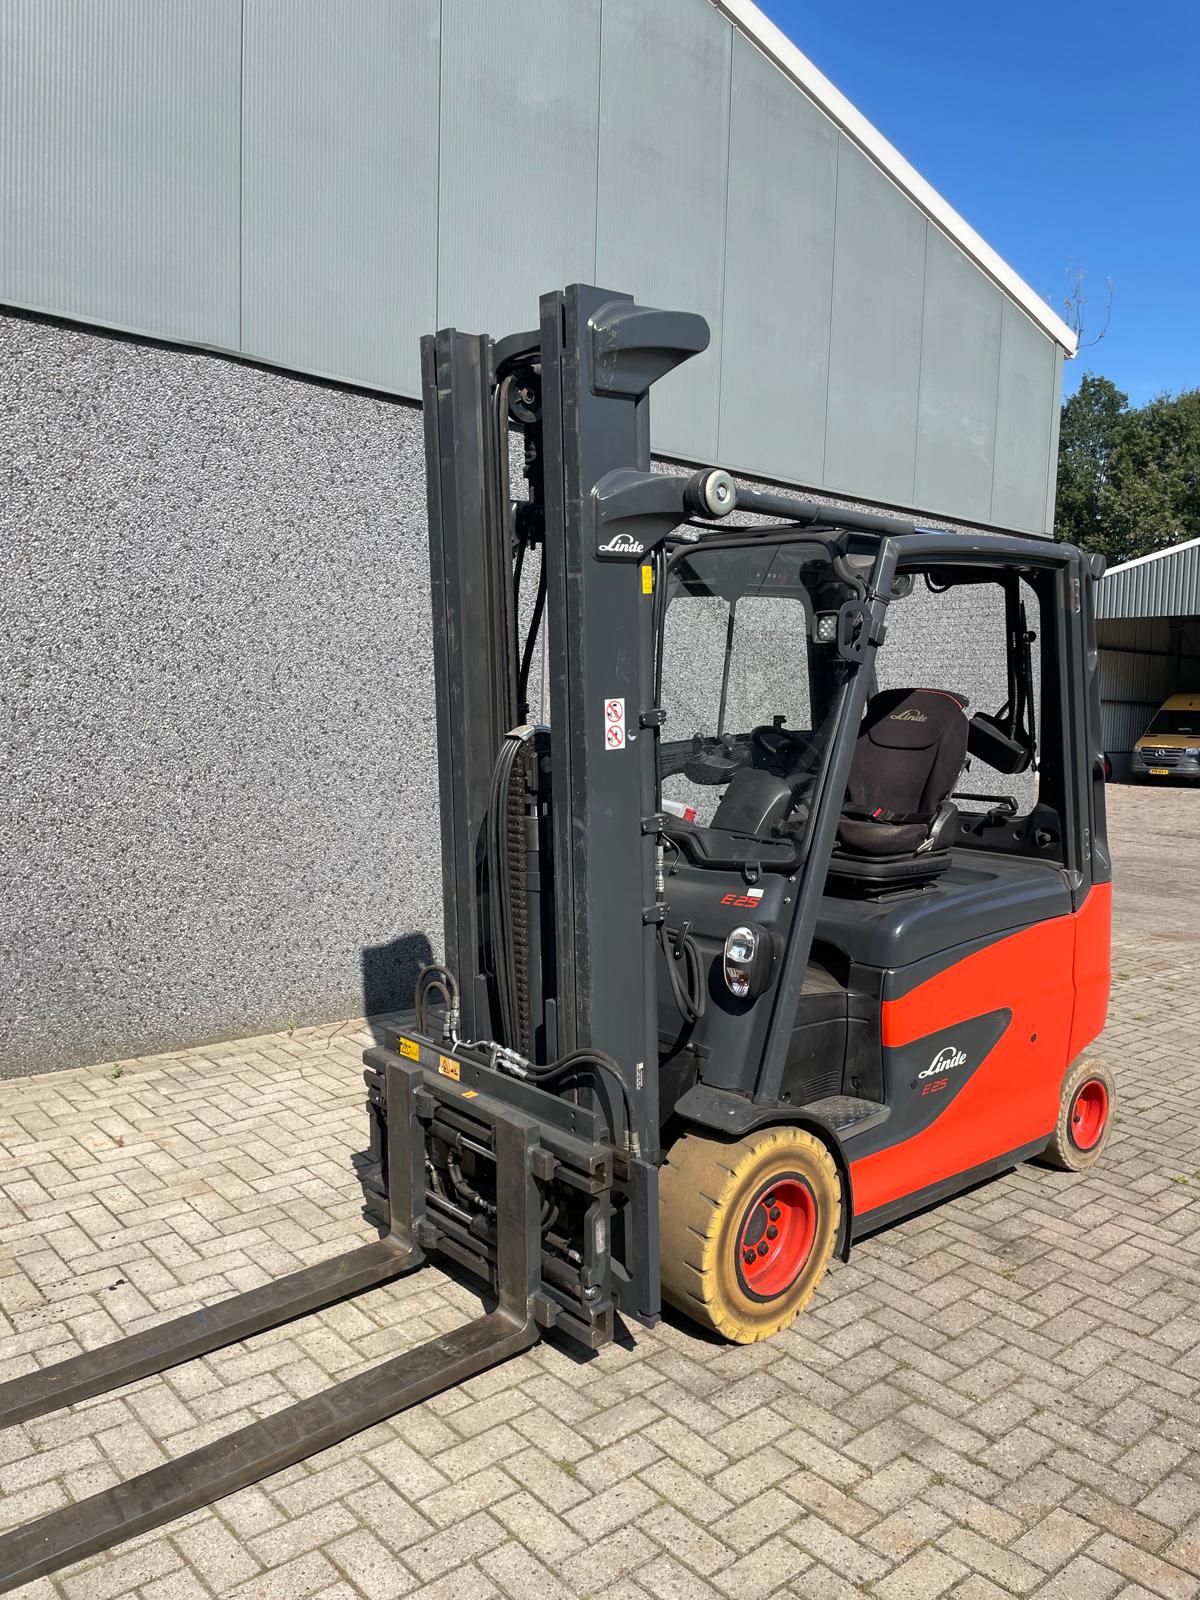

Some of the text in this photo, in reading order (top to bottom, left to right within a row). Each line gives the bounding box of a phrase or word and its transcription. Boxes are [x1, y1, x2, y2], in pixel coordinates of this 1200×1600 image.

[598, 533, 644, 553] Linde
[889, 708, 929, 722] Linde
[918, 1046, 967, 1079] Linde
